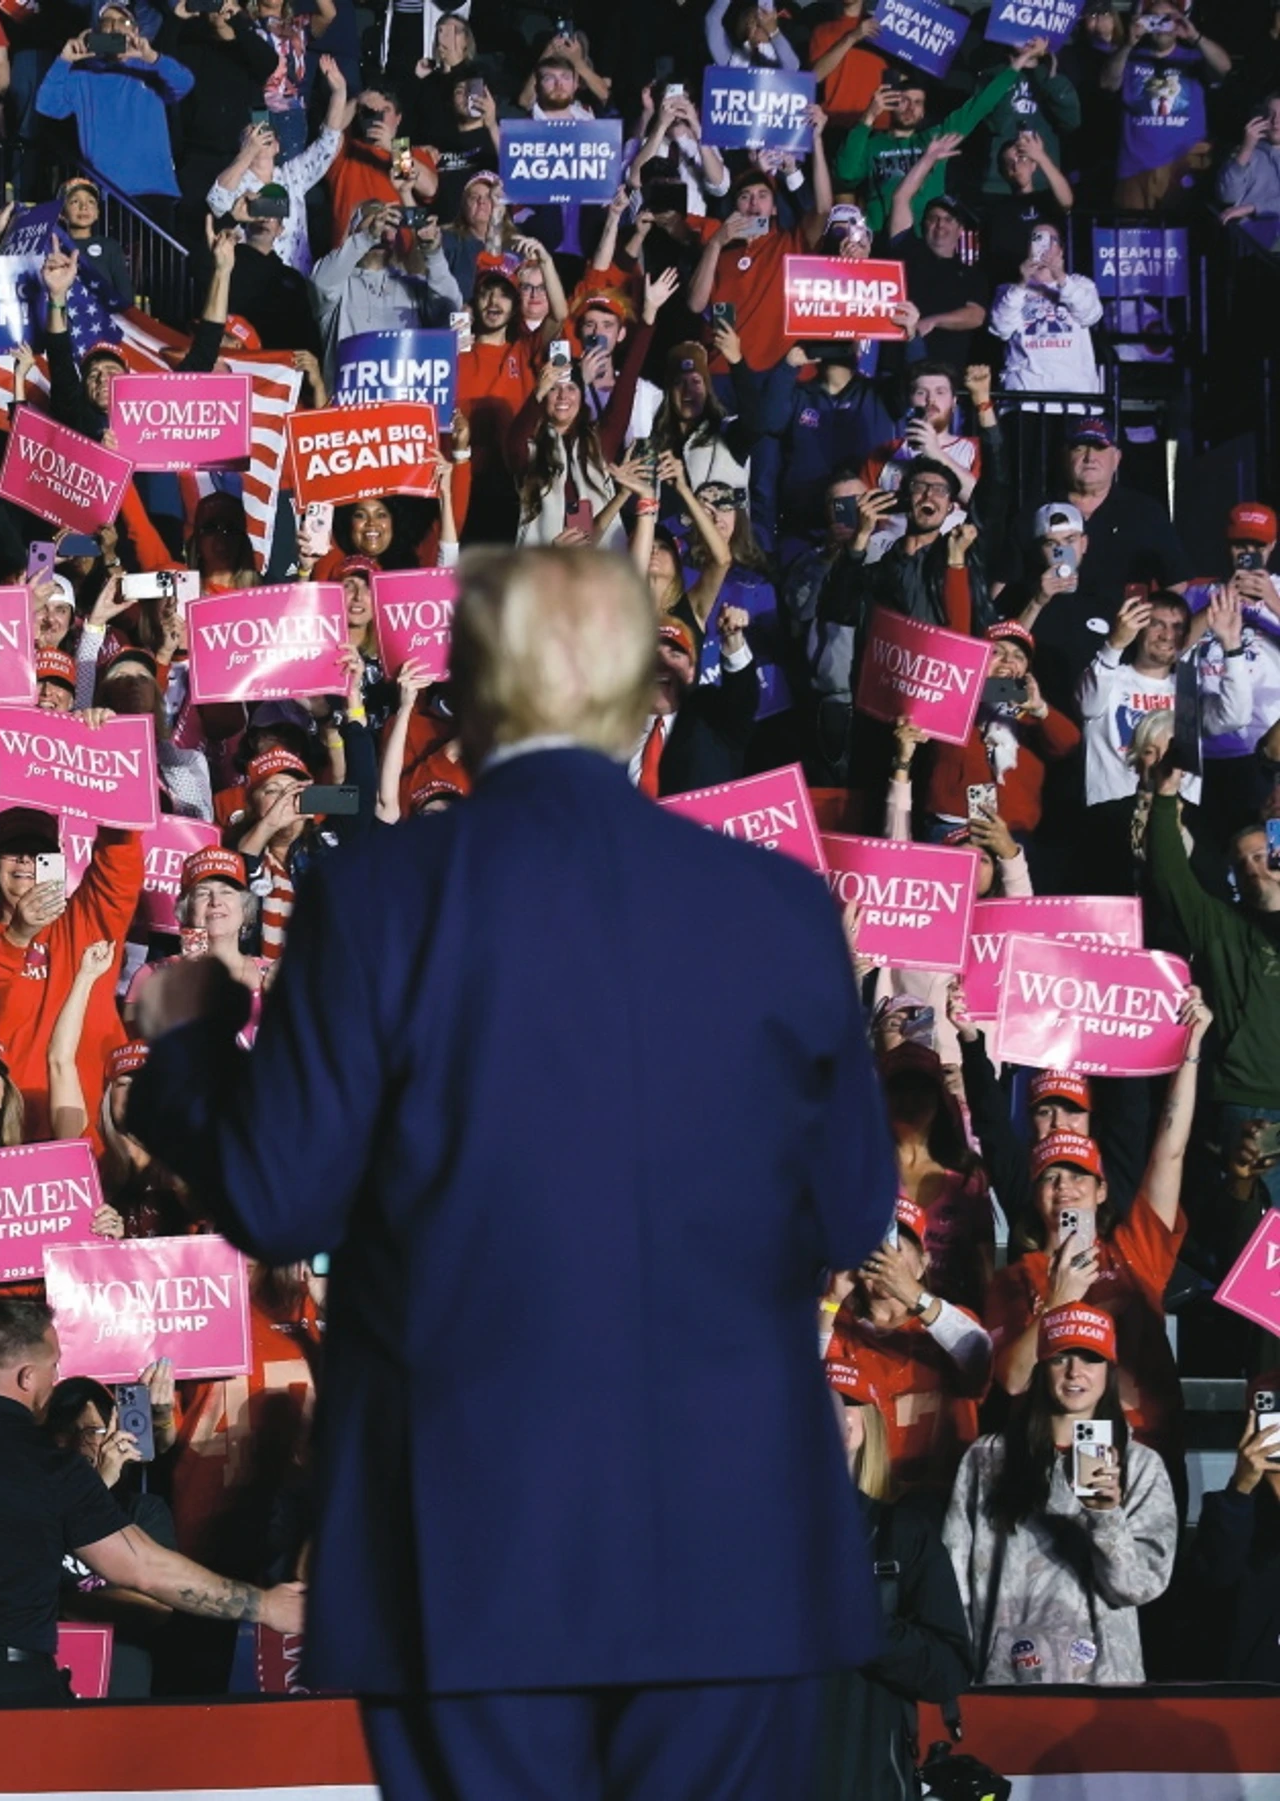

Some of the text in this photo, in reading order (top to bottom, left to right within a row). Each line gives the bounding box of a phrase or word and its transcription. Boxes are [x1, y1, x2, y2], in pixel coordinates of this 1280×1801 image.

[999, 5, 1069, 33] AGAIN!
[880, 14, 948, 56] AGAIN!
[711, 88, 808, 112] TRUMP
[711, 111, 805, 129] WILL FIX IT
[508, 143, 616, 160] DREAM BIG,
[510, 160, 606, 180] AGAIN!
[793, 279, 898, 300] TRUMP
[793, 302, 842, 317] WILL
[845, 302, 877, 317] FIX
[340, 359, 451, 387] TRUMP
[432, 387, 447, 405] IT
[118, 398, 241, 427] WOMEN
[140, 426, 220, 443] for TRUMP
[298, 424, 433, 454] DREAM BIG,
[18, 434, 117, 504] WOMEN
[306, 444, 425, 479] AGAIN!
[46, 477, 90, 509] TRUMP
[198, 613, 341, 650] WOMEN
[226, 647, 320, 670] for TRUMP
[871, 637, 975, 693] WOMEN
[892, 674, 944, 703] TRUMP
[25, 762, 118, 793] for TRUMP
[866, 910, 931, 929] RUMP
[1017, 971, 1184, 1024] WOMEN
[1070, 1016, 1154, 1040] TRUMP
[2, 1266, 36, 1278] 2024
[74, 1275, 233, 1319] WOMEN
[124, 1314, 208, 1333] TRUMP
